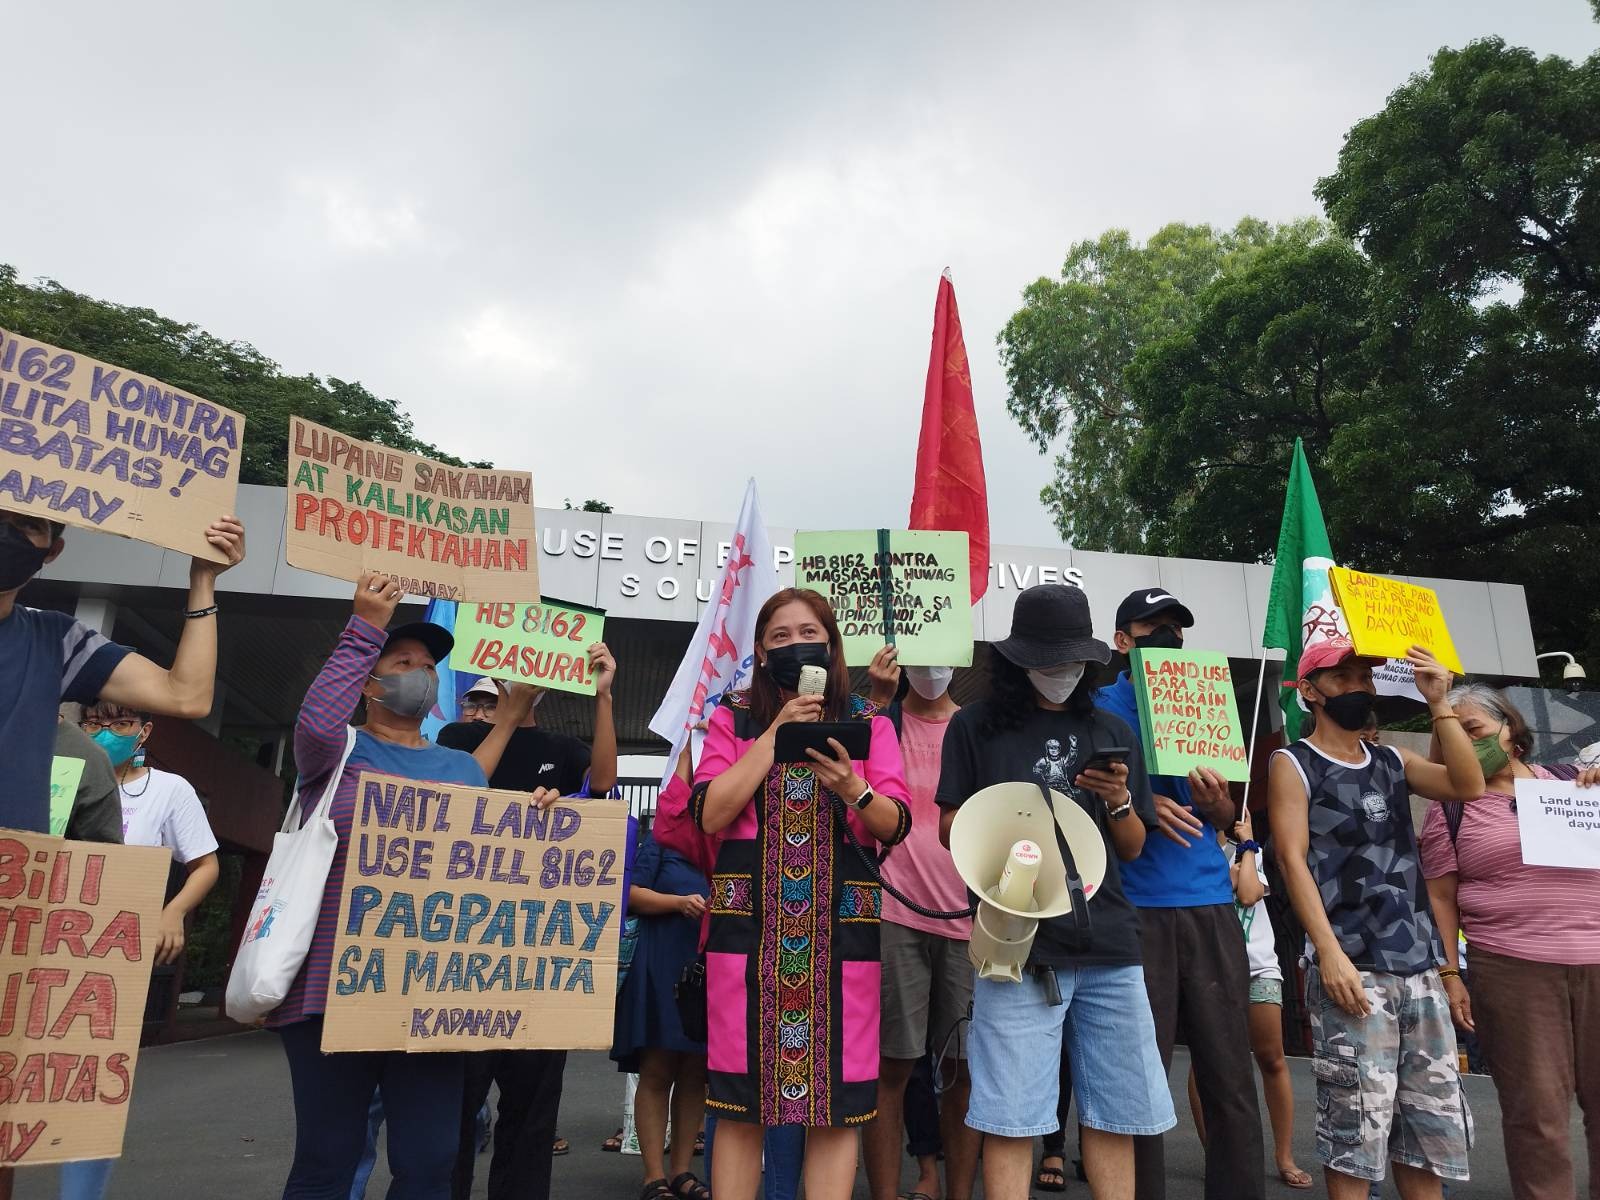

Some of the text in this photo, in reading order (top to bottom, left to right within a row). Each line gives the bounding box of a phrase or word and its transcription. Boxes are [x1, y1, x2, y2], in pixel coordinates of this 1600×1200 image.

[0, 331, 237, 449] 162 KONTRA
[0, 378, 229, 478] LITA HUWAG
[294, 421, 531, 504] LUPANG SAKAHAN
[294, 461, 509, 535] AT KALIKASAN
[295, 493, 528, 570] PROTEKTAHAN
[543, 528, 623, 560] USE
[645, 536, 698, 566] OF
[829, 553, 865, 569] 8162
[620, 573, 714, 602] SOU
[904, 568, 955, 582] HUWAG
[1349, 572, 1379, 587] LAND
[857, 595, 882, 609] USE
[933, 595, 952, 610] SA
[923, 609, 942, 623] SA
[476, 603, 586, 641] HB 8162
[470, 639, 594, 685] IBASURA!
[1145, 660, 1230, 682] LAND USE
[1147, 676, 1215, 692] PARA SA
[1152, 687, 1226, 706] PAGKAIN
[1154, 703, 1229, 723] HINDI SA
[1154, 720, 1230, 740] NEGOSYO
[1155, 737, 1169, 750] AT
[1539, 796, 1600, 807] Land use
[1545, 806, 1594, 818] Pilipino
[471, 796, 581, 842] LAND
[358, 834, 617, 889] USE BILL 8162
[346, 885, 615, 952] PAGPATAY
[336, 945, 595, 996] SA MARALITA
[410, 1008, 522, 1039] KADAMAY
